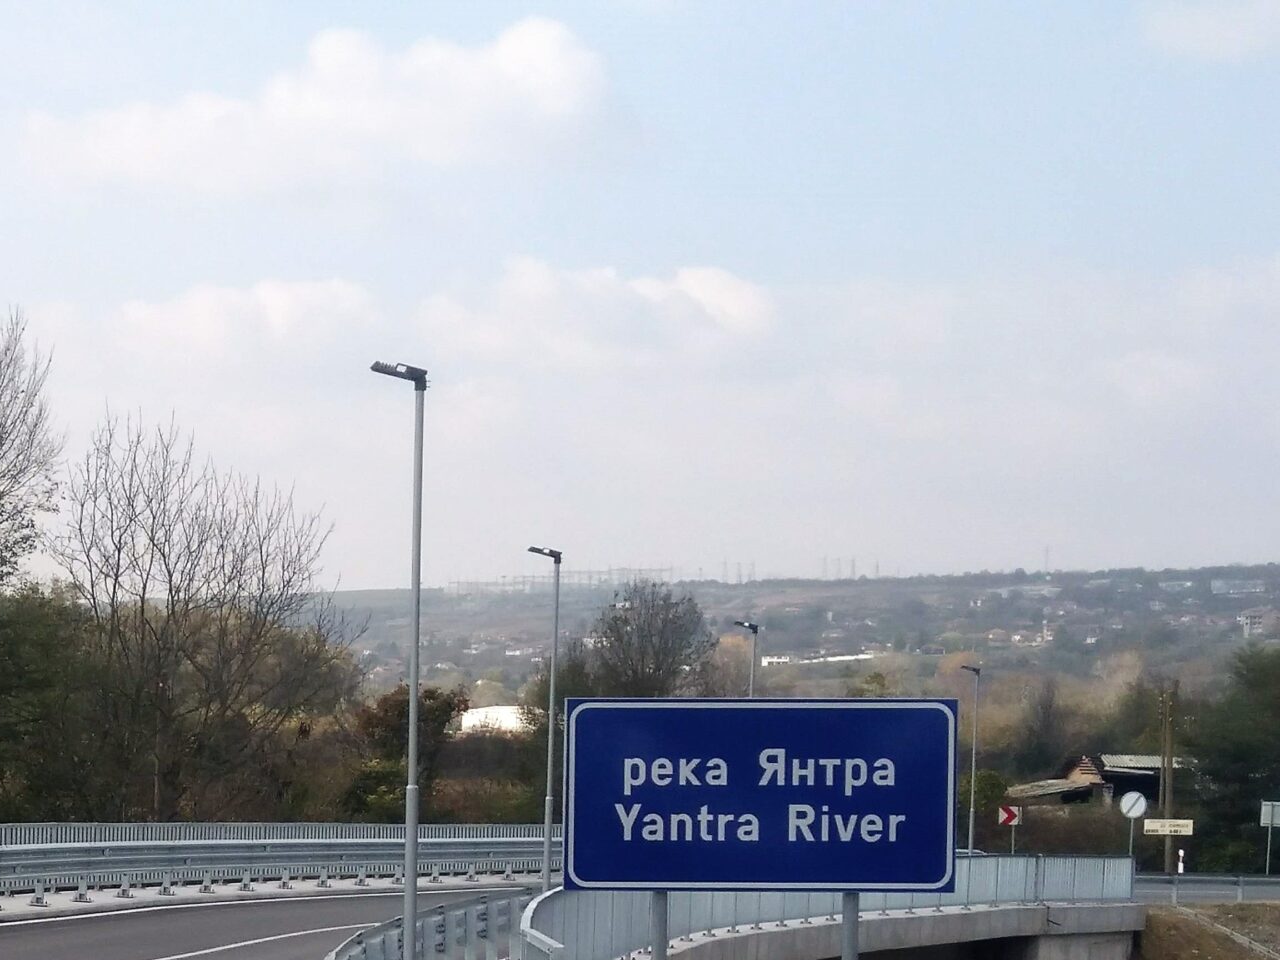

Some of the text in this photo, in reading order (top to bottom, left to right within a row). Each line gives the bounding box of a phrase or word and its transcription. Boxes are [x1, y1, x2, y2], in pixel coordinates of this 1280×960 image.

[624, 748, 895, 796] река Янтра
[615, 803, 906, 842] Yantra River
